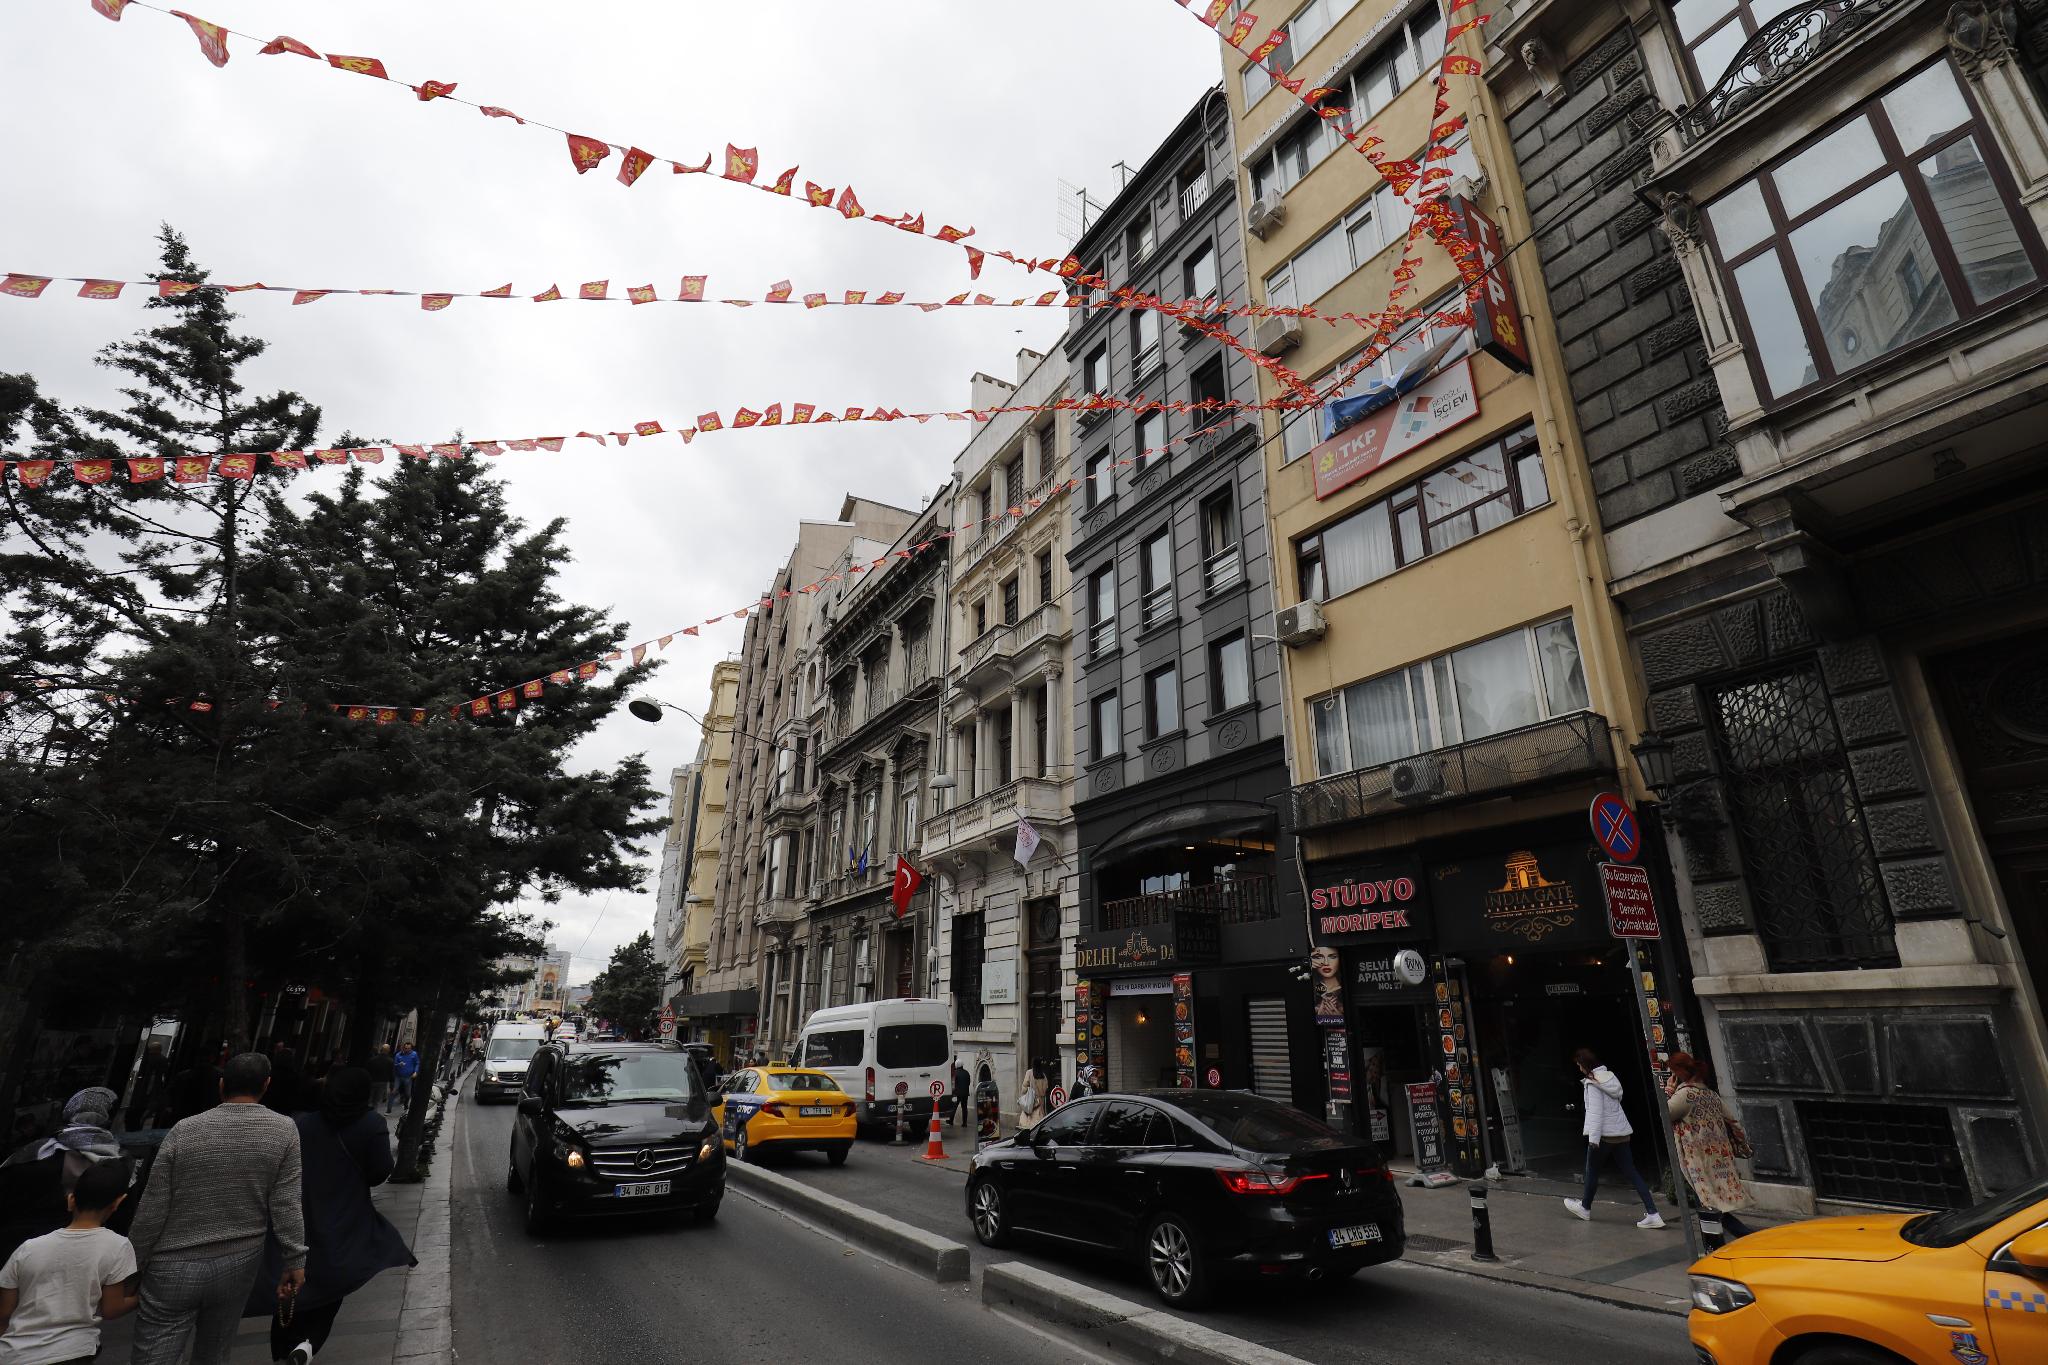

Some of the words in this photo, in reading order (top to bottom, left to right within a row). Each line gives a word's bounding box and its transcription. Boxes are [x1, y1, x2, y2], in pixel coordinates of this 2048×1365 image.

[1469, 209, 1505, 306] TKP
[1339, 428, 1377, 458] TKP
[1311, 877, 1414, 910] STÜDYO
[1484, 891, 1532, 908] INDIA
[1534, 885, 1574, 902] GATE
[1618, 902, 1647, 916] Denetim
[1320, 908, 1408, 934] MORİPEK
[1077, 946, 1117, 968] DELHI
[1359, 957, 1390, 972] SELVİ
[1545, 983, 1580, 995] WELCOME
[620, 1186, 631, 1197] 34
[634, 1185, 650, 1196] BHS
[654, 1183, 669, 1194] 813
[1333, 1228, 1345, 1243] 34
[1363, 1224, 1379, 1238] 559
